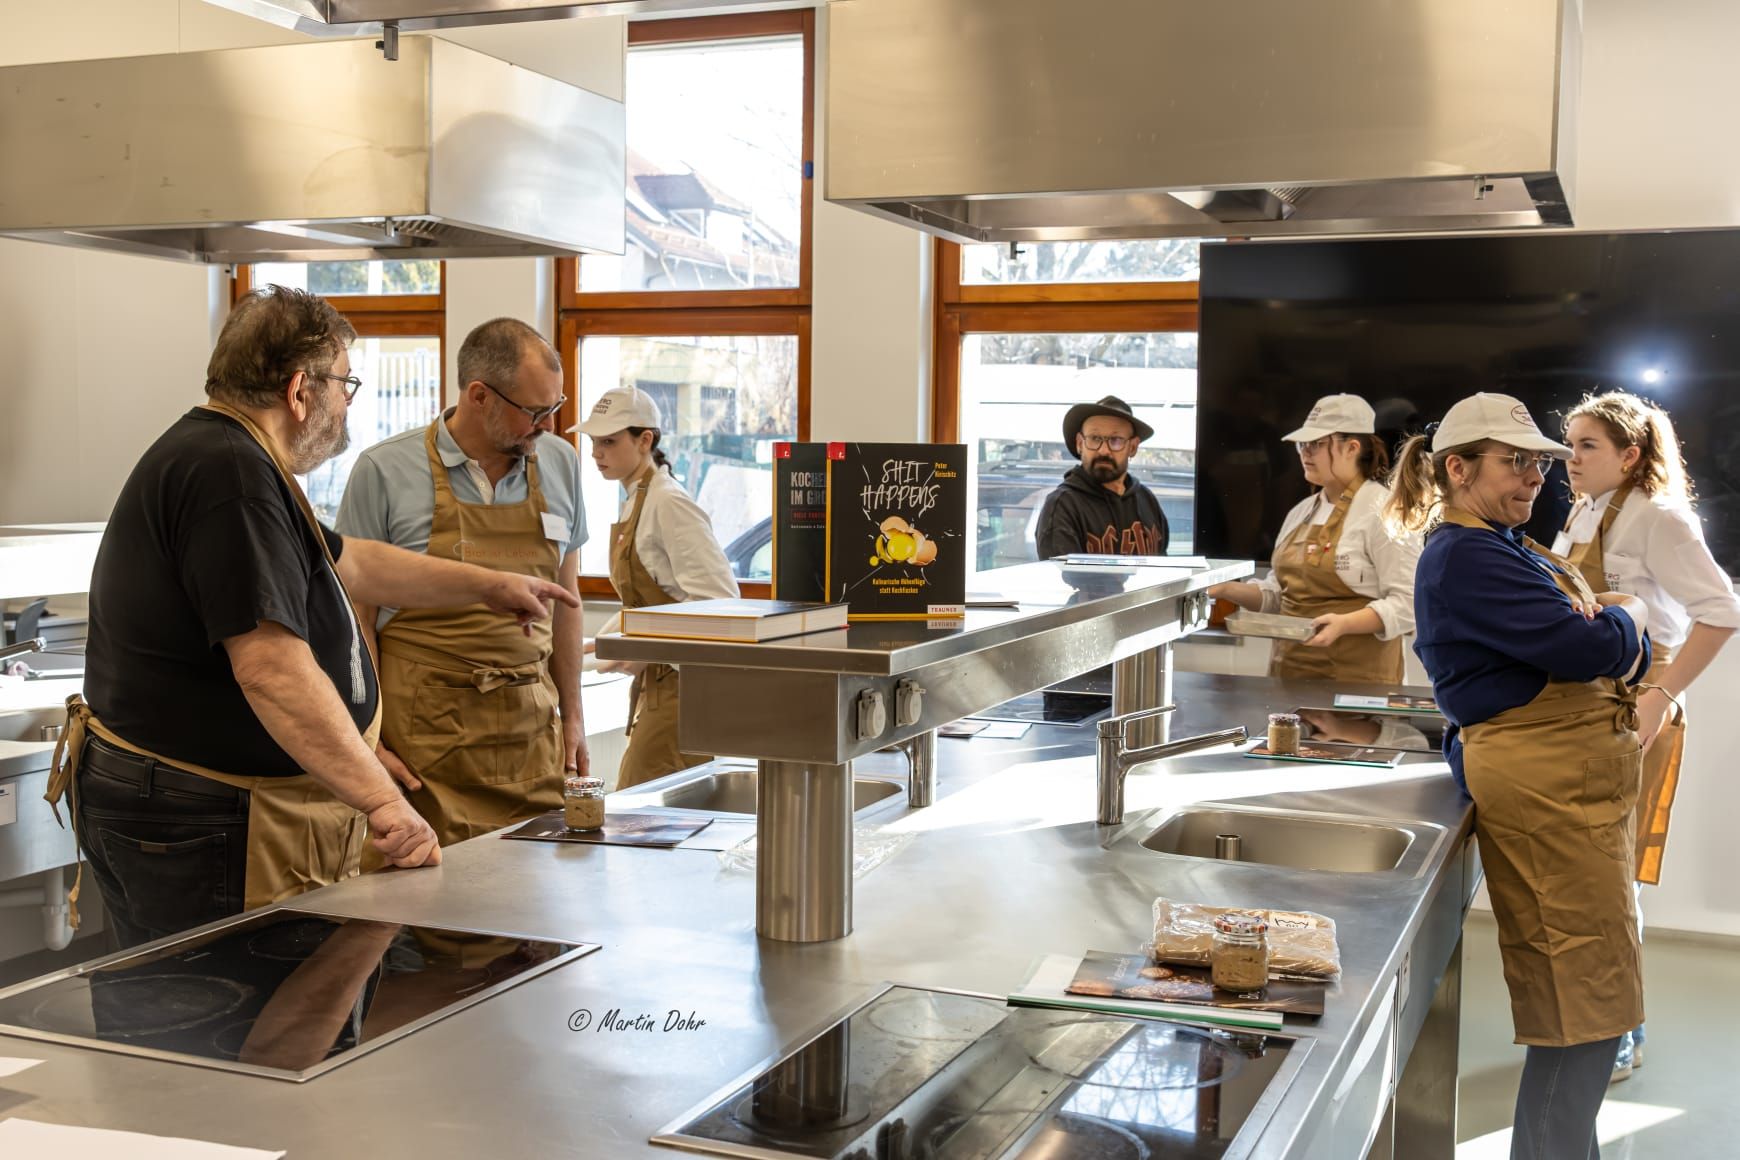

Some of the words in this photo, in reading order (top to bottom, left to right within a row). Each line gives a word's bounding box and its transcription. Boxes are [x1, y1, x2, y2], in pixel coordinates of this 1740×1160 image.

[881, 459, 929, 485] SHIT
[790, 490, 803, 505] IM
[860, 484, 940, 510] HAPPENS
